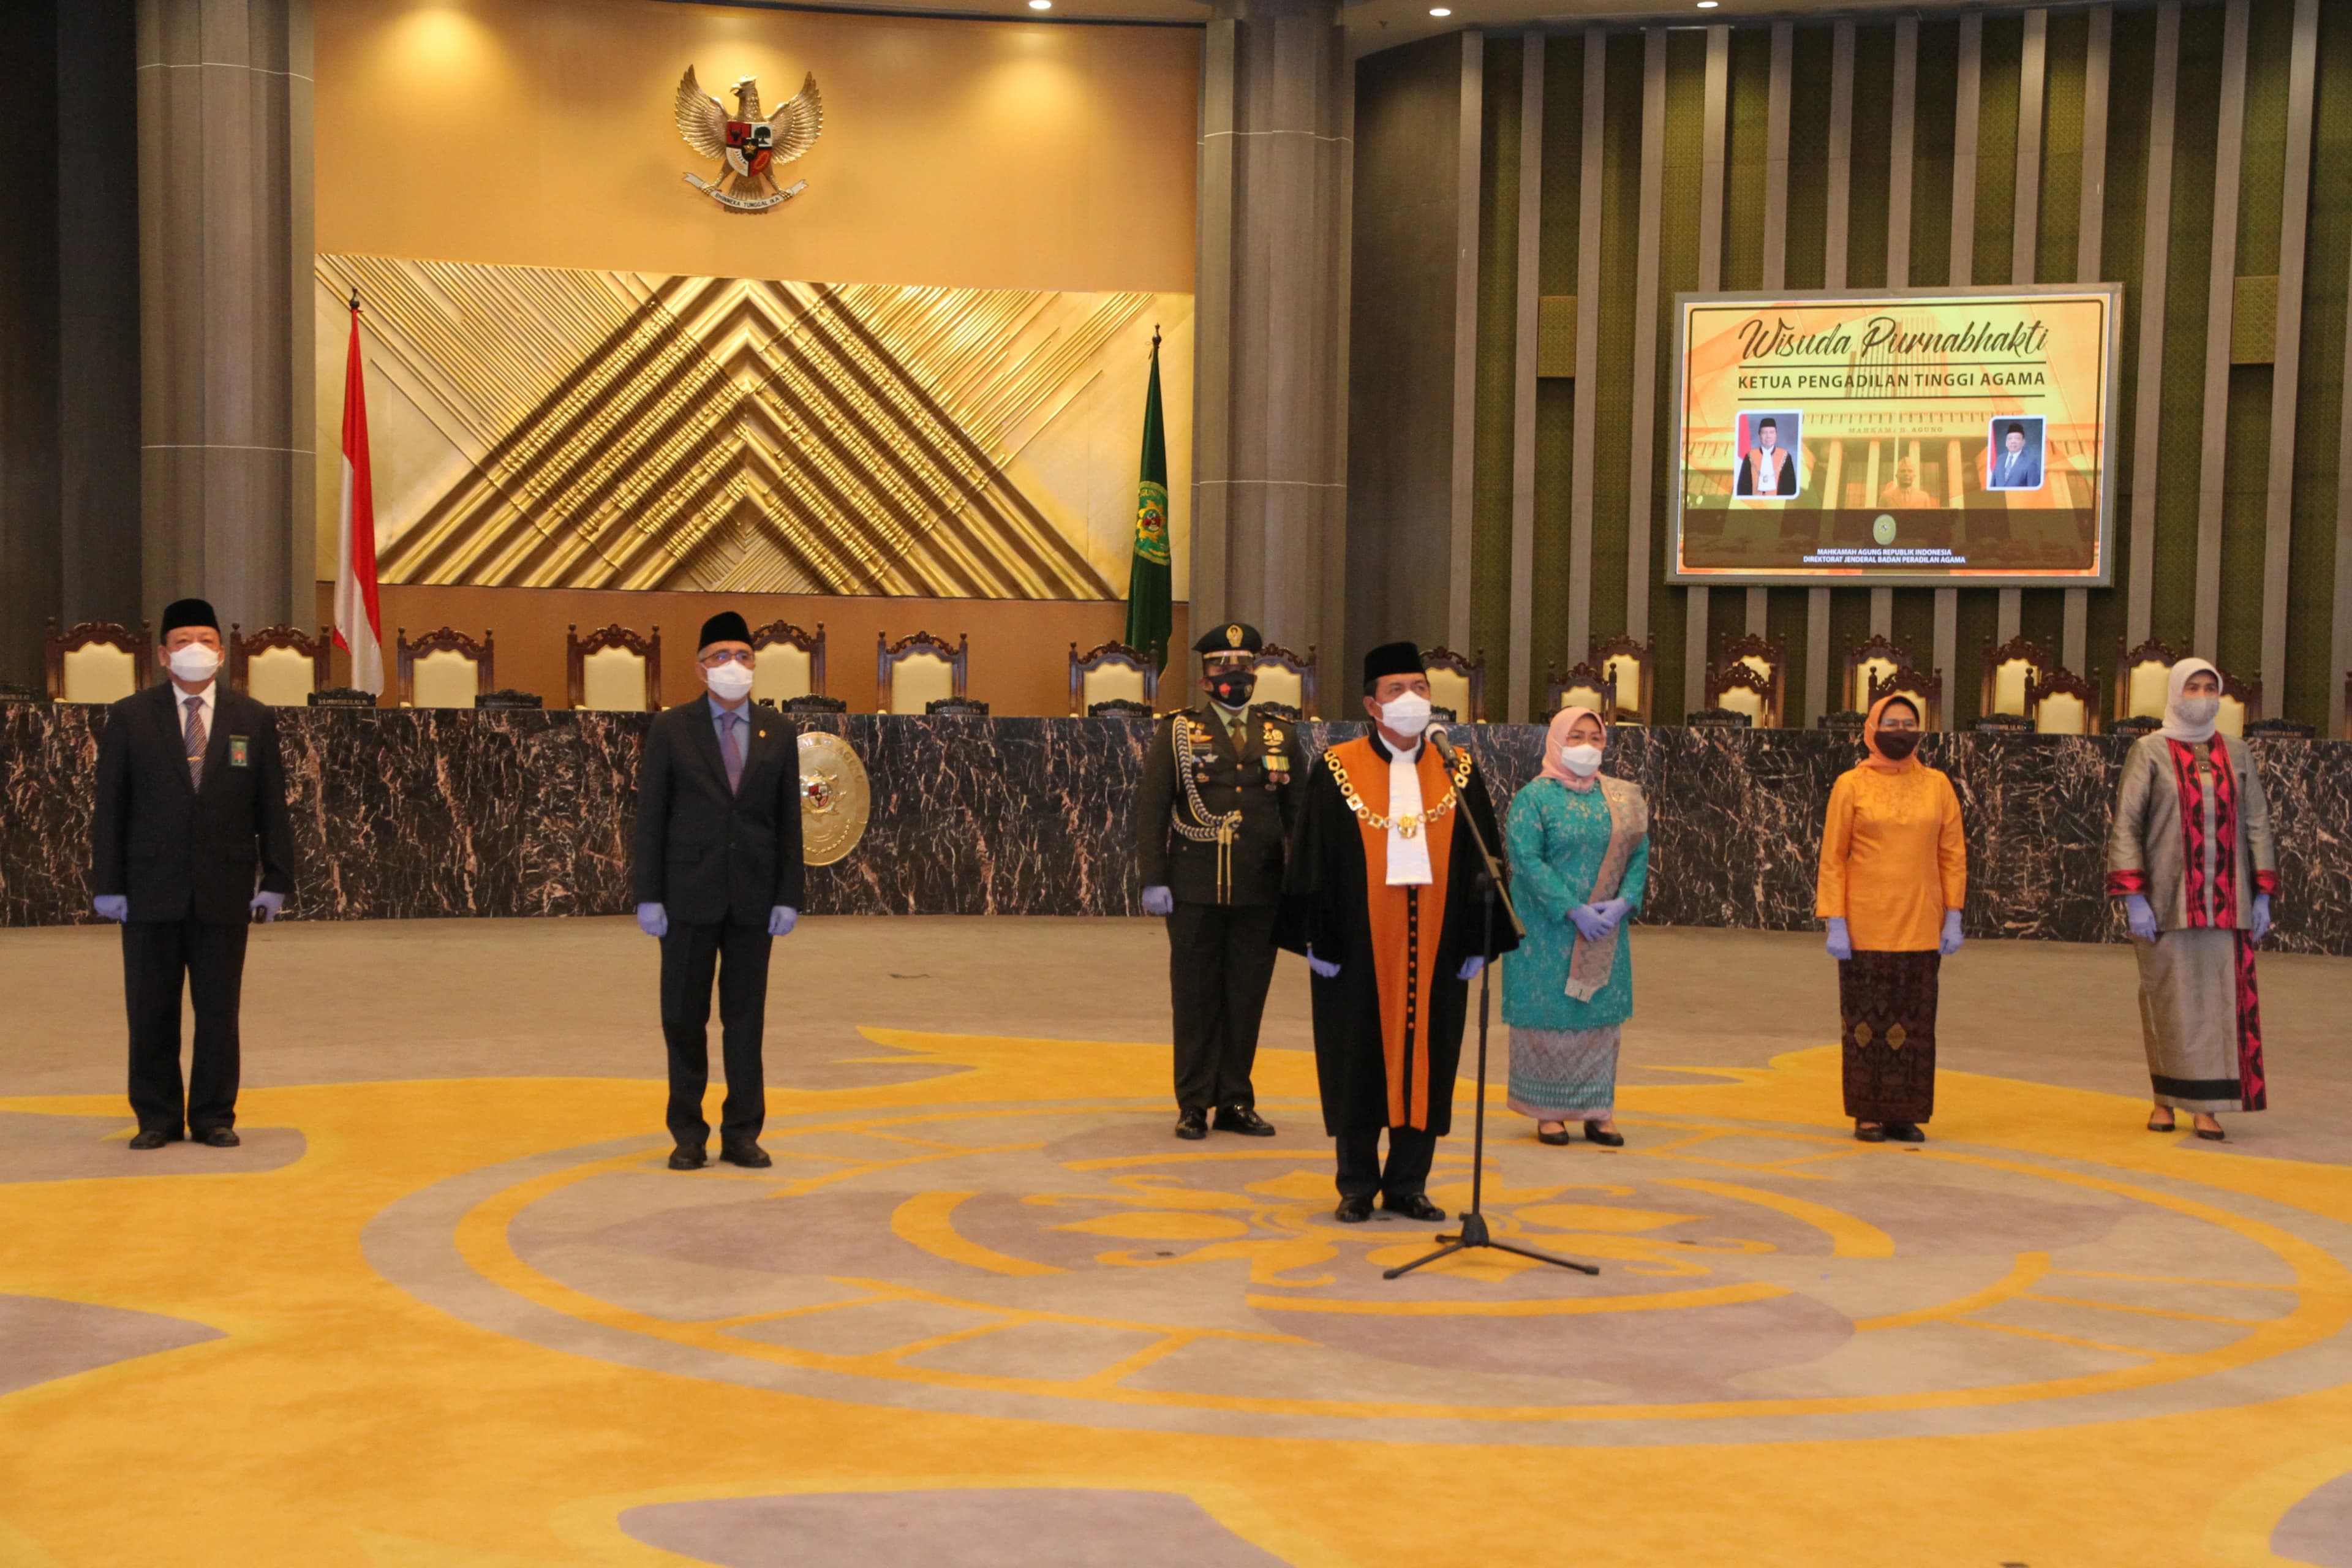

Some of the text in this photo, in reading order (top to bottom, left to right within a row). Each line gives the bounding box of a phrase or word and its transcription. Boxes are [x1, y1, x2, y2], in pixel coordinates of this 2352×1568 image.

[715, 192, 741, 206] BHINNEKA
[1738, 317, 2048, 360] Wisuda Purnabhakti
[1738, 372, 2045, 389] KETUA PENGADILAN TINGGI AGAMA
